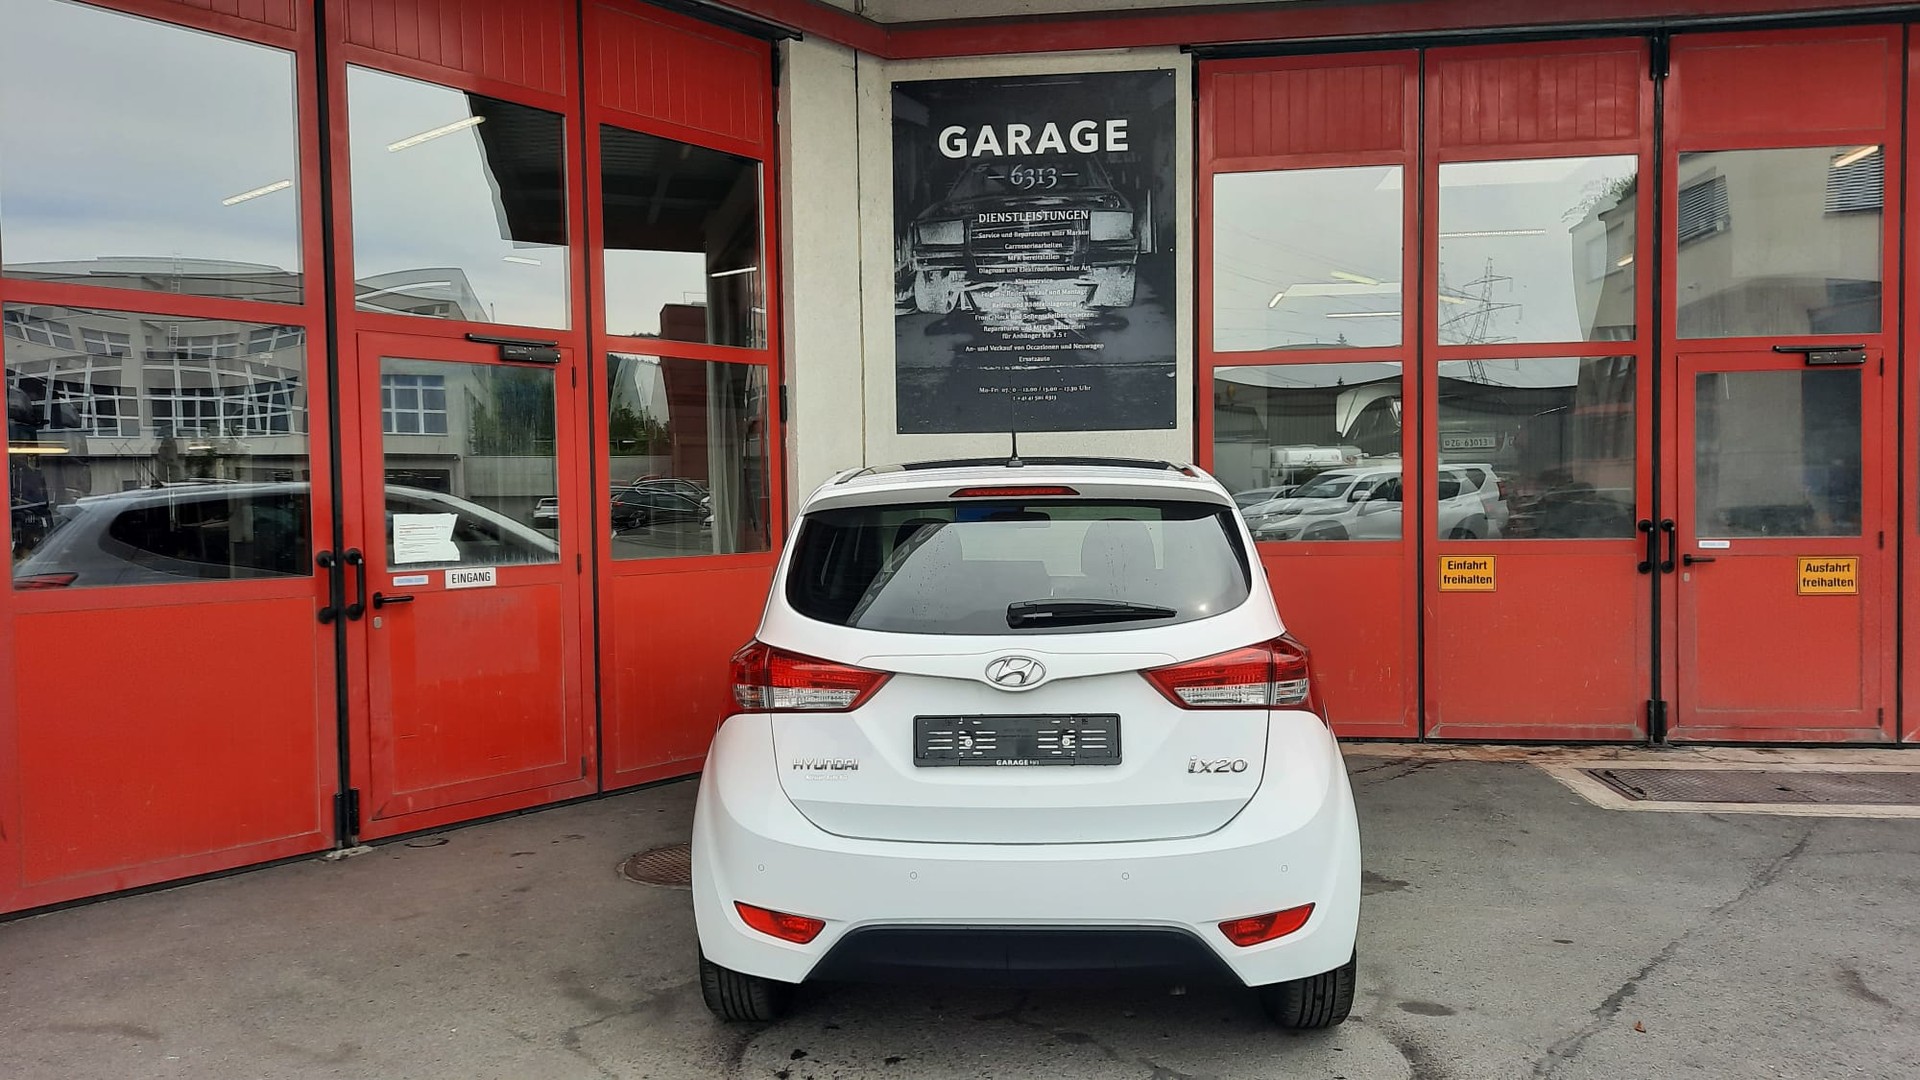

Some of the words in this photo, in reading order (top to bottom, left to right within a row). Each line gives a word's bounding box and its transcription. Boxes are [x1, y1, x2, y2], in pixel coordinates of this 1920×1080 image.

[938, 119, 1129, 158] GARAGE
[1010, 163, 1058, 190] 6313
[978, 209, 1089, 224] DIENSTLEISTUNGEN
[1014, 231, 1051, 239] Reparaturen
[979, 267, 1006, 275] Diagnose
[1012, 333, 1041, 341] Anhänger
[1073, 343, 1105, 351] Neuwagen
[1447, 560, 1488, 570] Einfahrt
[1805, 563, 1851, 573] Ausfahrt
[451, 571, 491, 584] EINGANG
[1443, 574, 1493, 584] freihalten
[1802, 577, 1854, 587] freihalten
[793, 757, 859, 771] HYUNDAI
